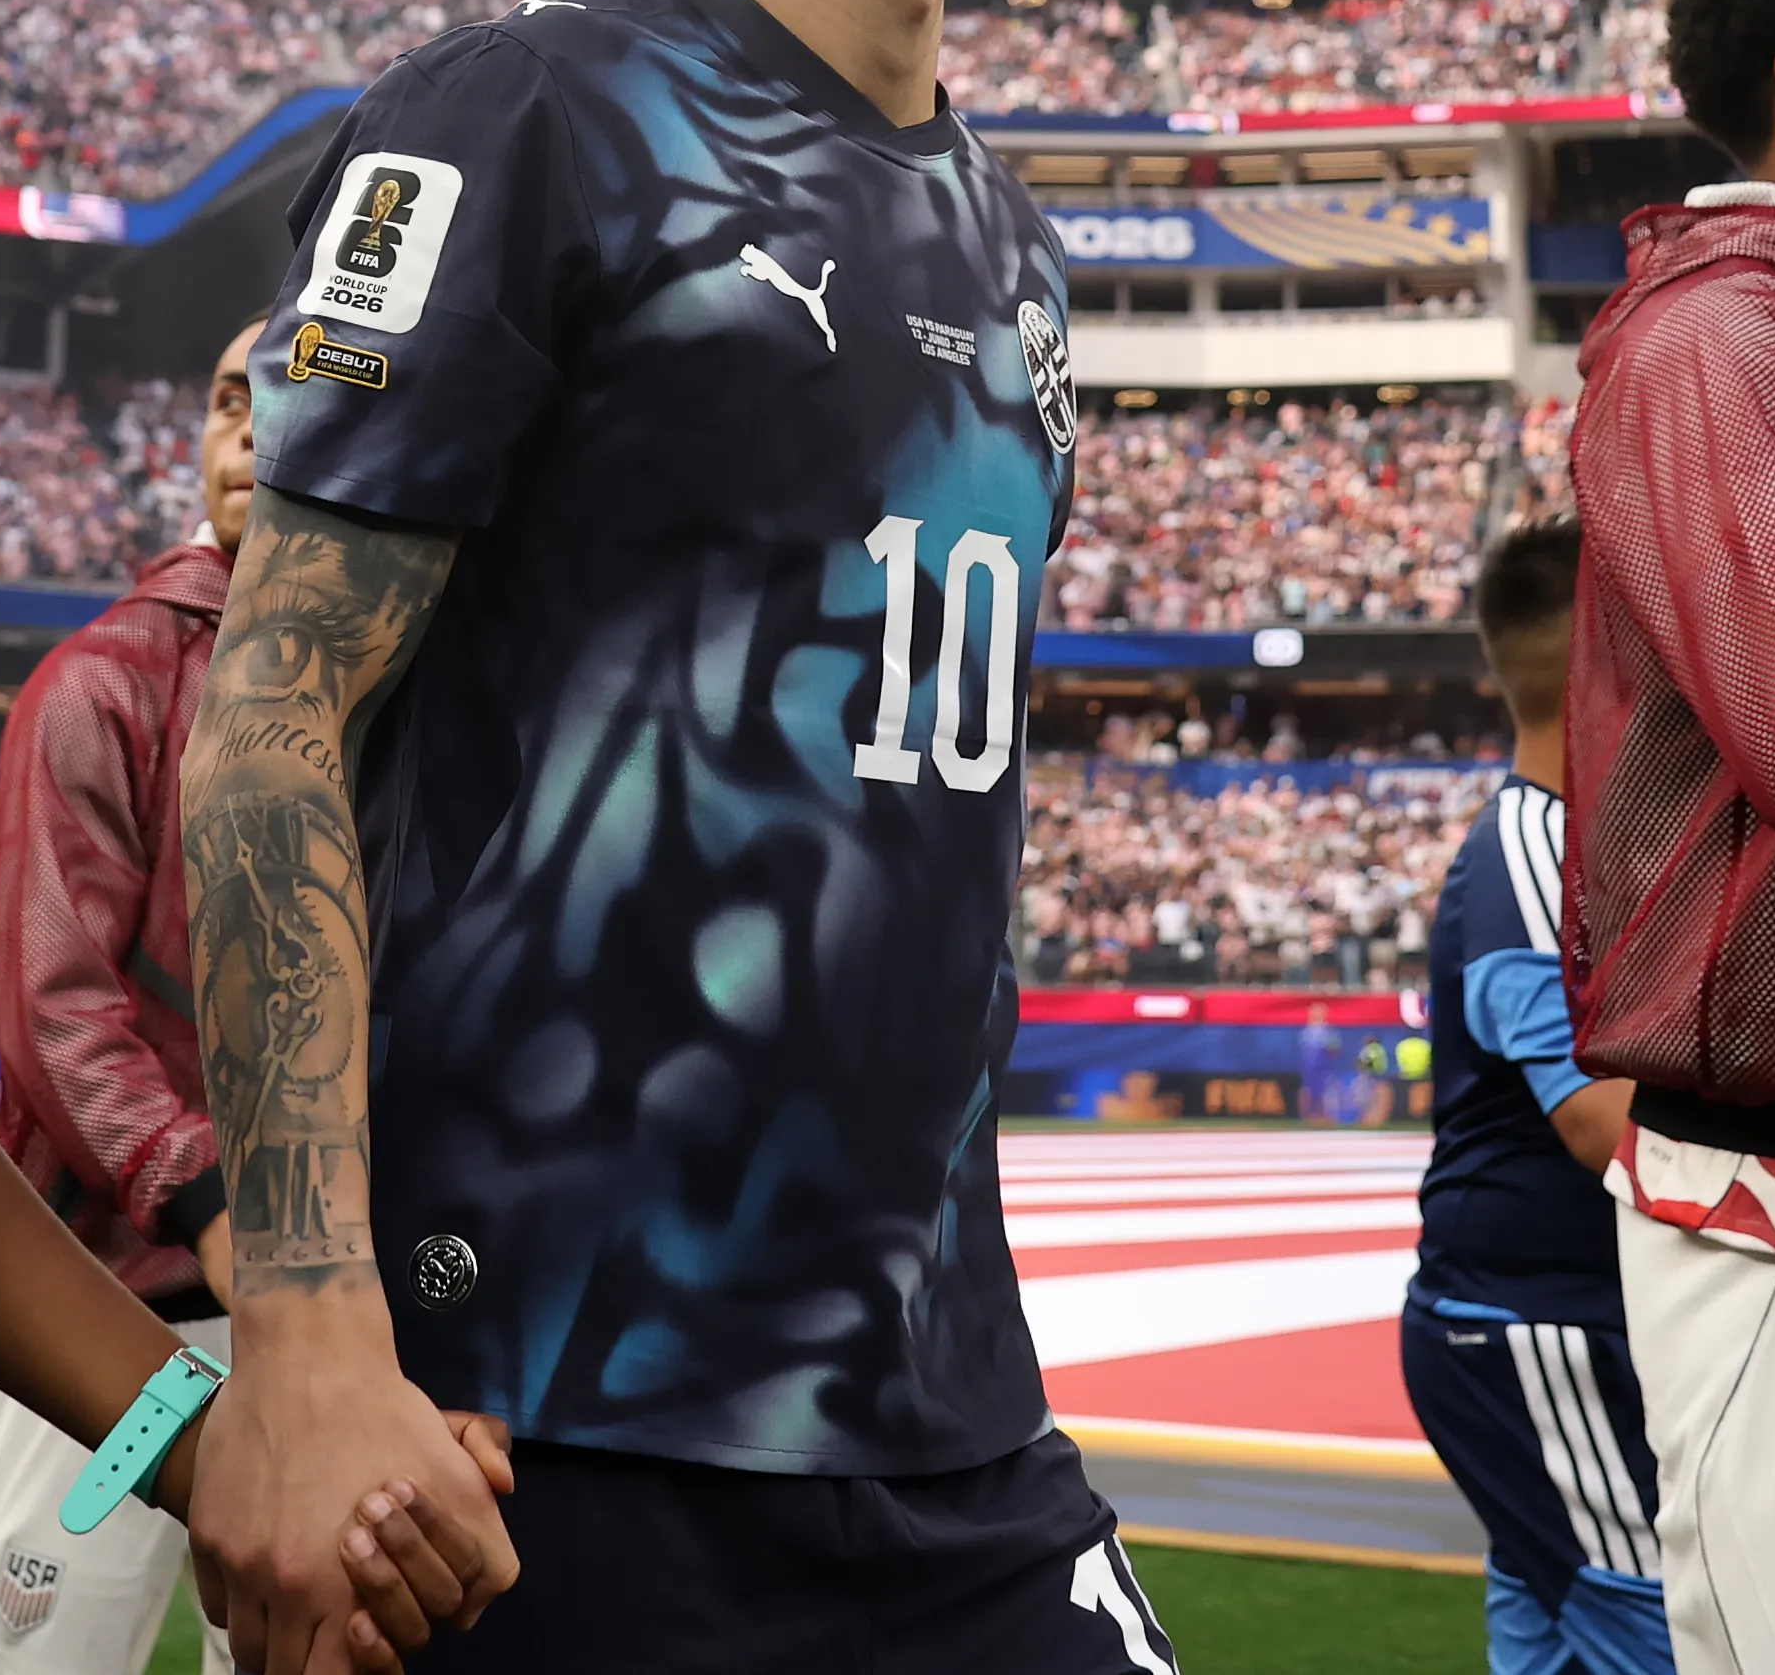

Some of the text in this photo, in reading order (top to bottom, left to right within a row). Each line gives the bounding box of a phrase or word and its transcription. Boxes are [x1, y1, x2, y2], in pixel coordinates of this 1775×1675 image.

[349, 251, 379, 269] FIFA
[321, 286, 384, 313] 2026
[366, 283, 388, 295] CUP
[905, 313, 975, 343] USA VS PARAGUAY
[911, 327, 923, 340] 12
[927, 332, 951, 349] JUNIO
[955, 340, 976, 355] 2026
[317, 347, 381, 371] DEBUT
[920, 341, 971, 366] LOS ANGELES
[852, 514, 1020, 793] 10
[1204, 1078, 1283, 1116] FIFA
[7, 1552, 58, 1589] USA
[1070, 1534, 1183, 1675] 1
